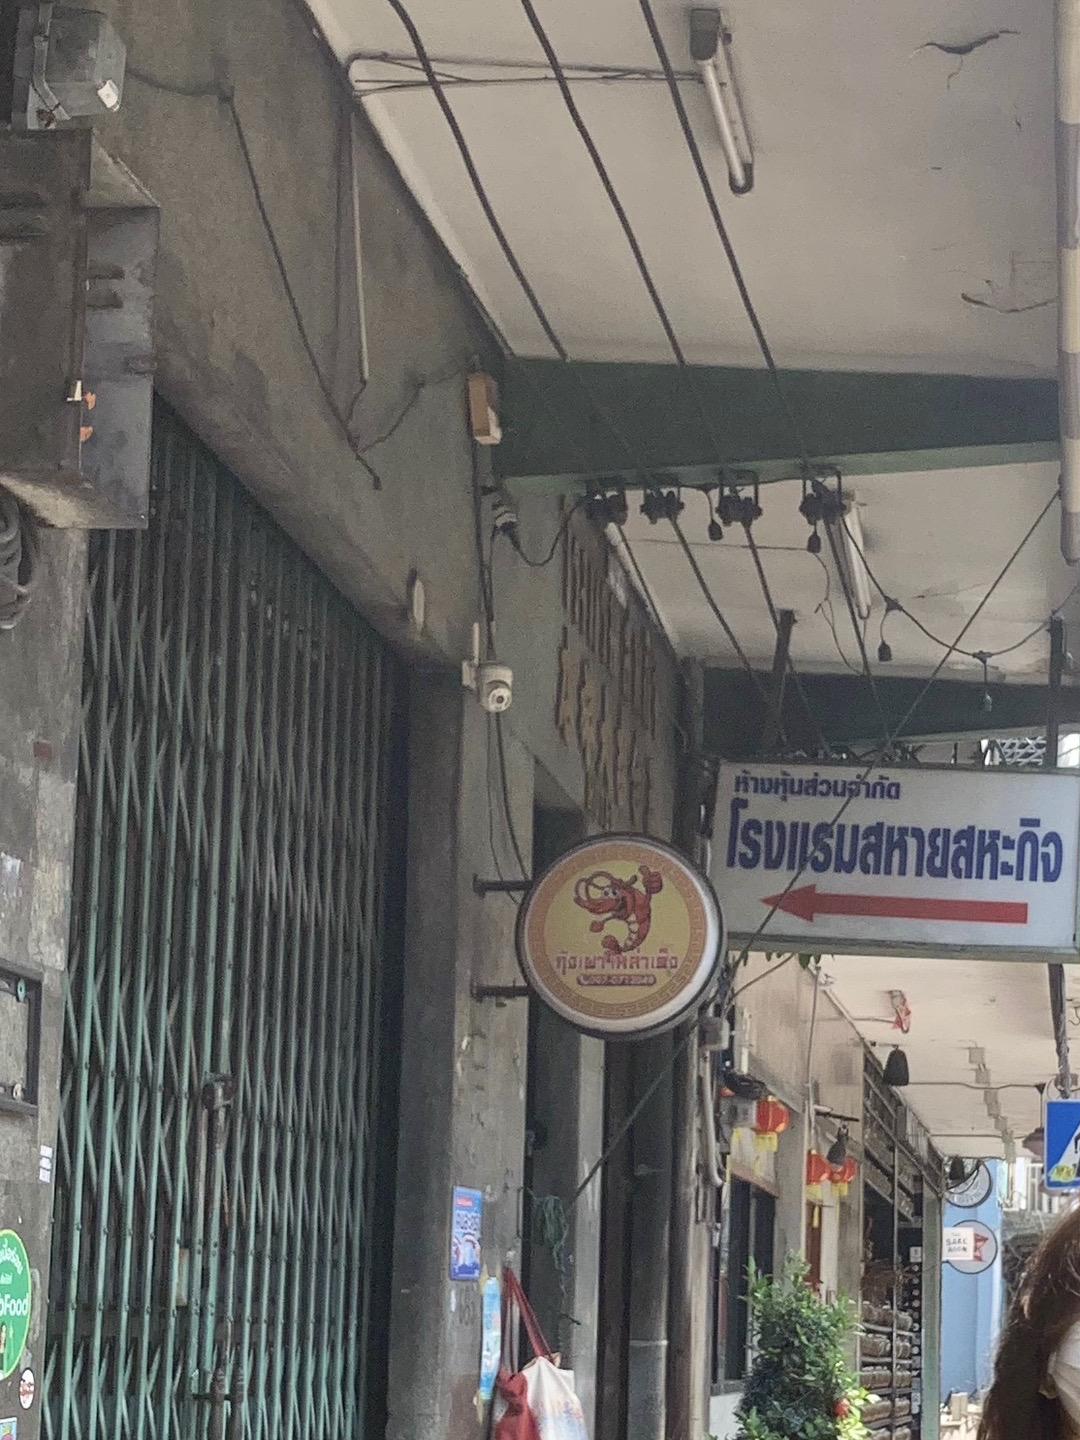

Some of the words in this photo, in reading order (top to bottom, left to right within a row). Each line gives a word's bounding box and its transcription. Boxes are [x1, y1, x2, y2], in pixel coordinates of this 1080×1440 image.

[735, 769, 901, 801] ห้างหุ้นส่วนจำกัด
[726, 798, 1063, 883] โรงแรมสหายสหะกิจ
